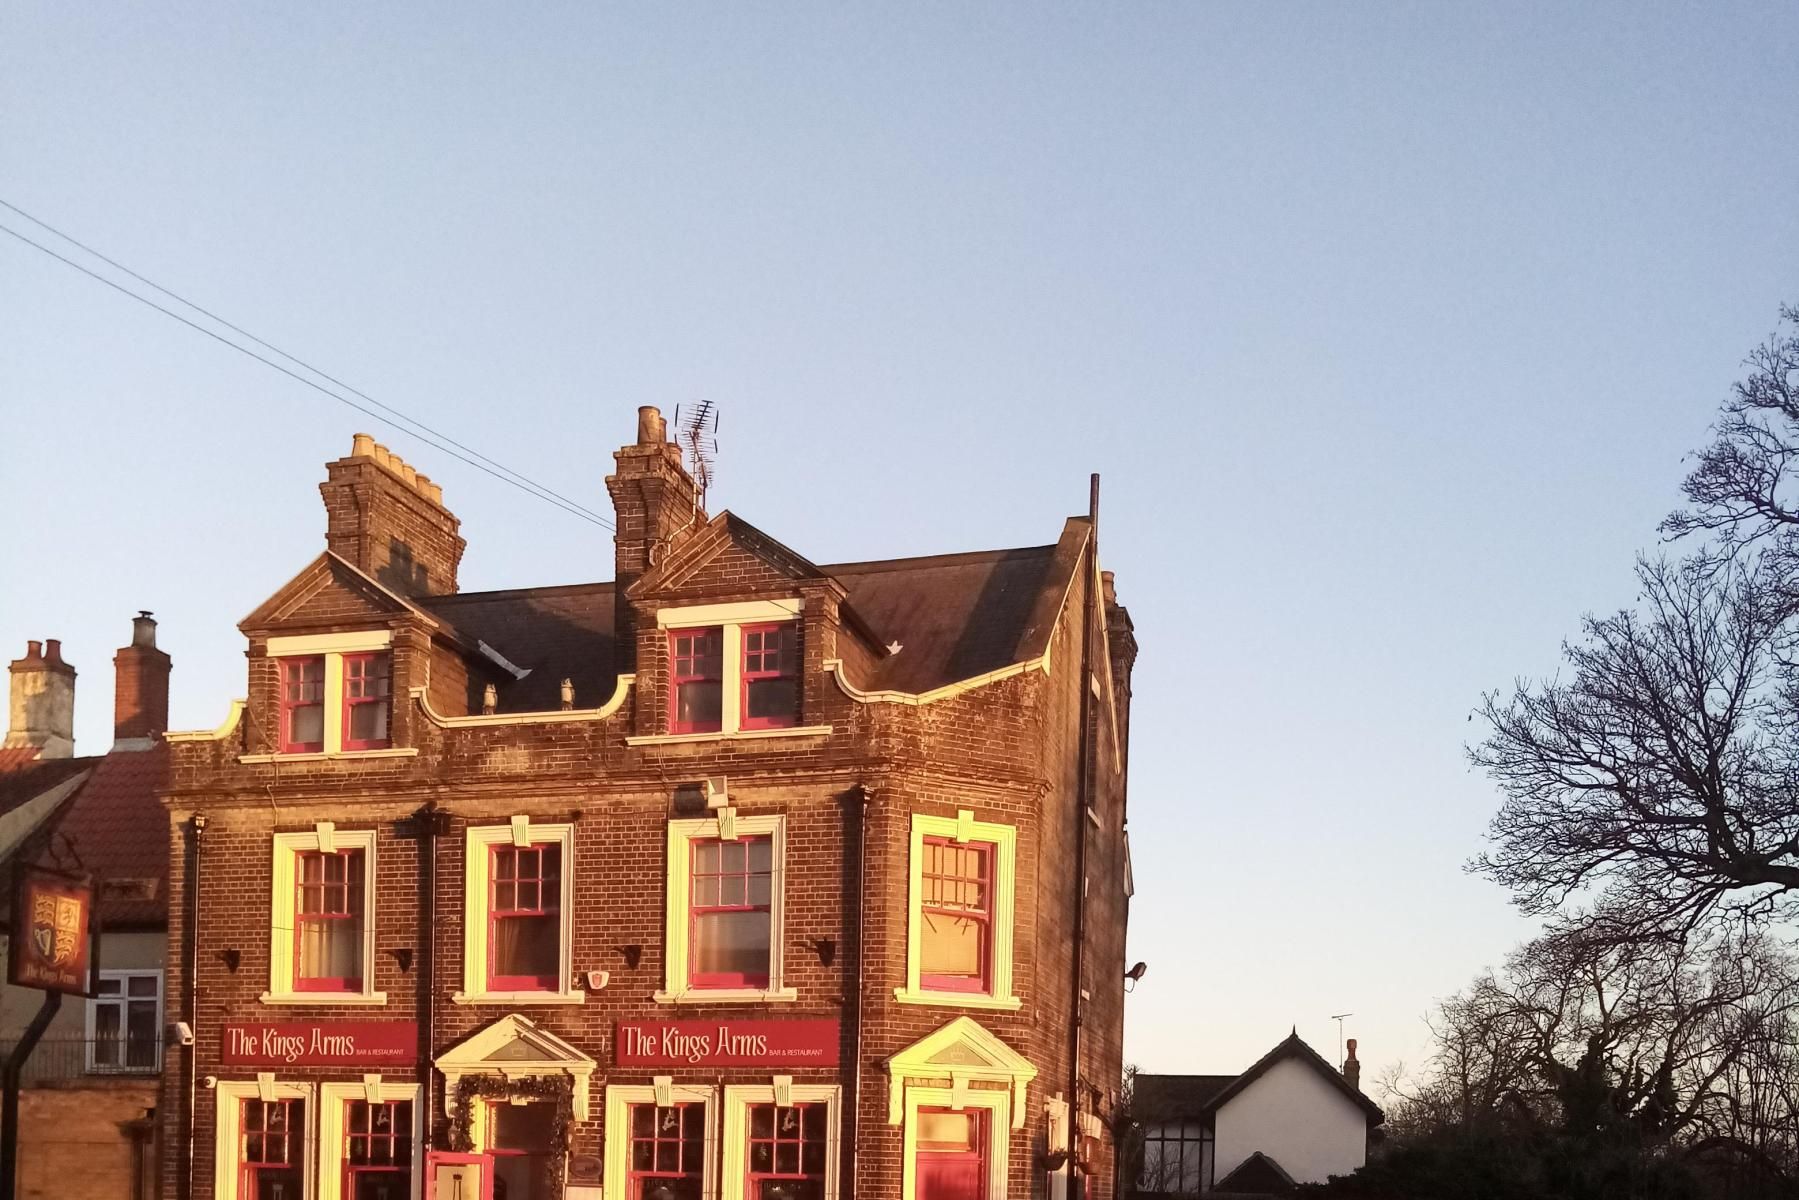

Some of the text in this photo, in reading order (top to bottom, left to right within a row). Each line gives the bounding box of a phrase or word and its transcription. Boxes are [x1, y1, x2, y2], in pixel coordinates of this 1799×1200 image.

[227, 1028, 258, 1056] The
[262, 1028, 305, 1063] Kings
[308, 1028, 354, 1056] Arms
[622, 1026, 656, 1056] The
[662, 1026, 710, 1063] Kings
[715, 1026, 767, 1056] Arms
